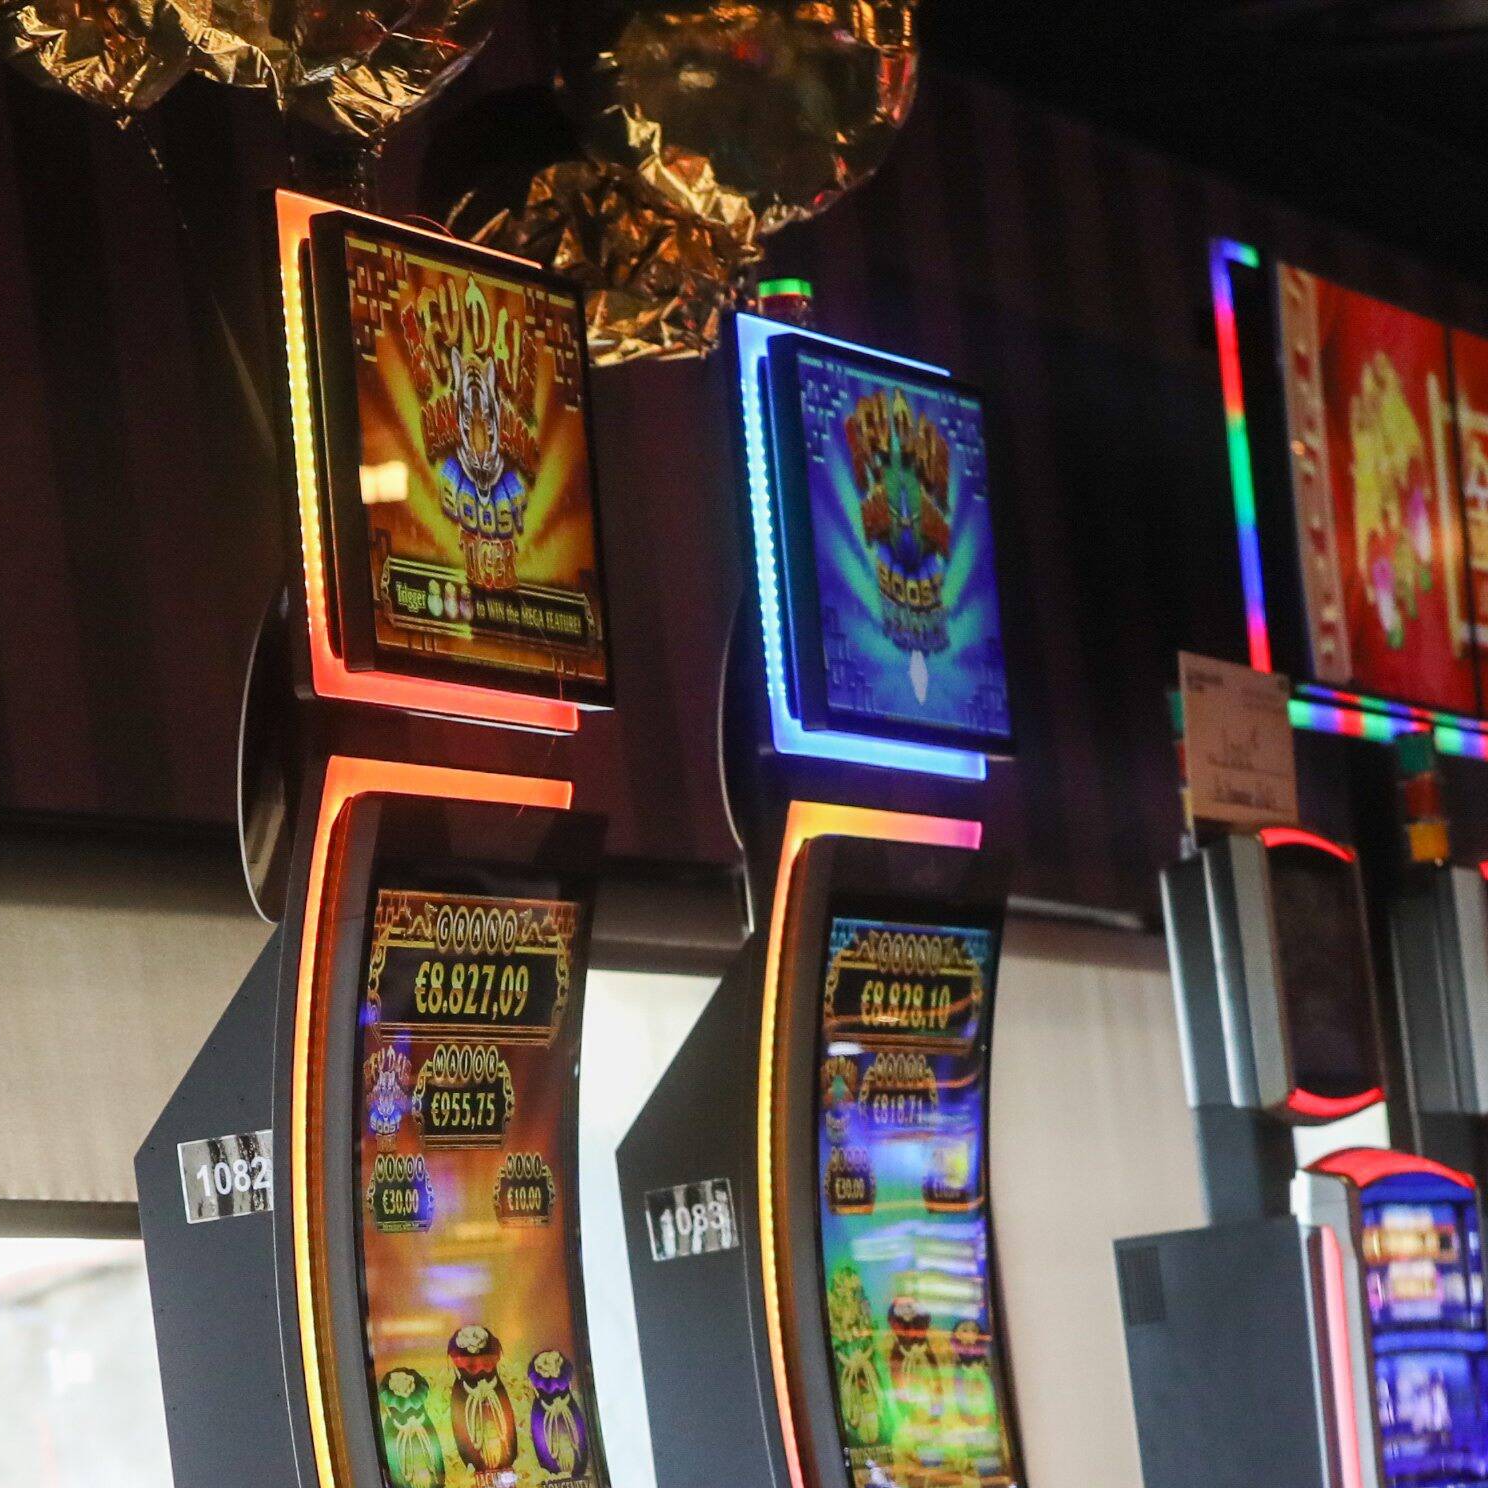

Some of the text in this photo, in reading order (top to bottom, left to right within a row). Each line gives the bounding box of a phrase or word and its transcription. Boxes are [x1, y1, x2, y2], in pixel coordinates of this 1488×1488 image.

[395, 580, 427, 612] Trigger
[487, 600, 505, 619] WIN
[506, 604, 520, 623] the
[521, 604, 544, 625] MEGA
[438, 908, 516, 951] GRAND
[415, 961, 530, 1020] €8.827,09
[431, 1091, 495, 1130] €955,75
[197, 1156, 273, 1197] 1082
[383, 1189, 419, 1216] €30,00
[507, 1187, 542, 1212] €10,00
